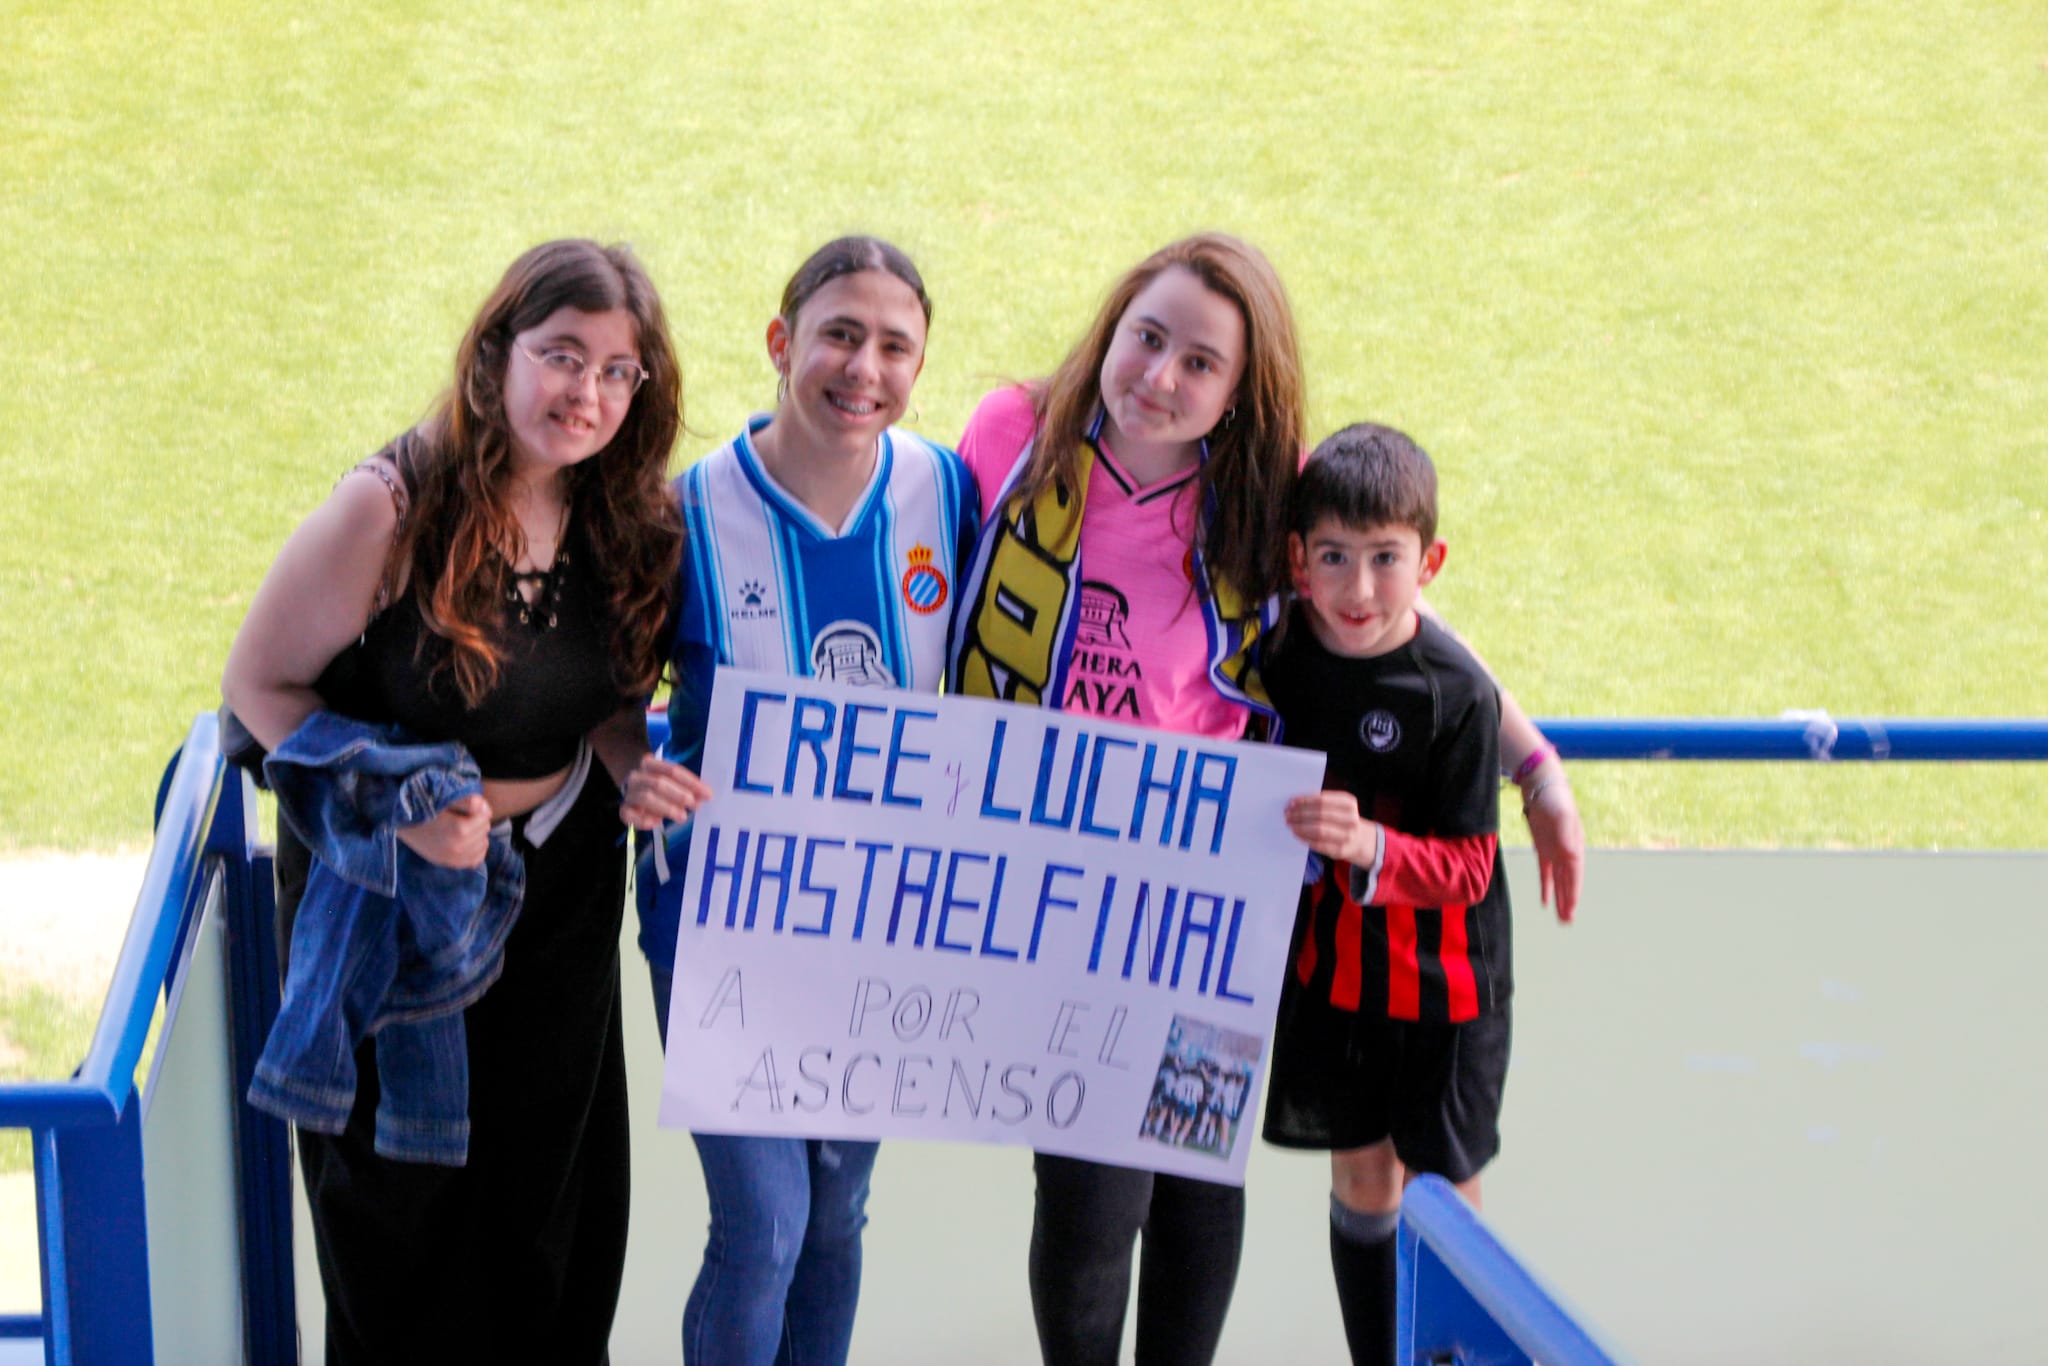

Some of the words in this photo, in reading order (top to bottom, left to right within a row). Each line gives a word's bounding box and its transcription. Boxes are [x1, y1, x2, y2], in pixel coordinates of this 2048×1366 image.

[730, 608, 777, 621] KELME
[1065, 679, 1141, 718] AYA
[733, 690, 938, 809] CREE
[979, 719, 1239, 856] LUCHA
[700, 966, 744, 1030] A
[849, 976, 981, 1043] POR
[1047, 1000, 1130, 1071] EL
[730, 1045, 1086, 1131] ASCENSO
